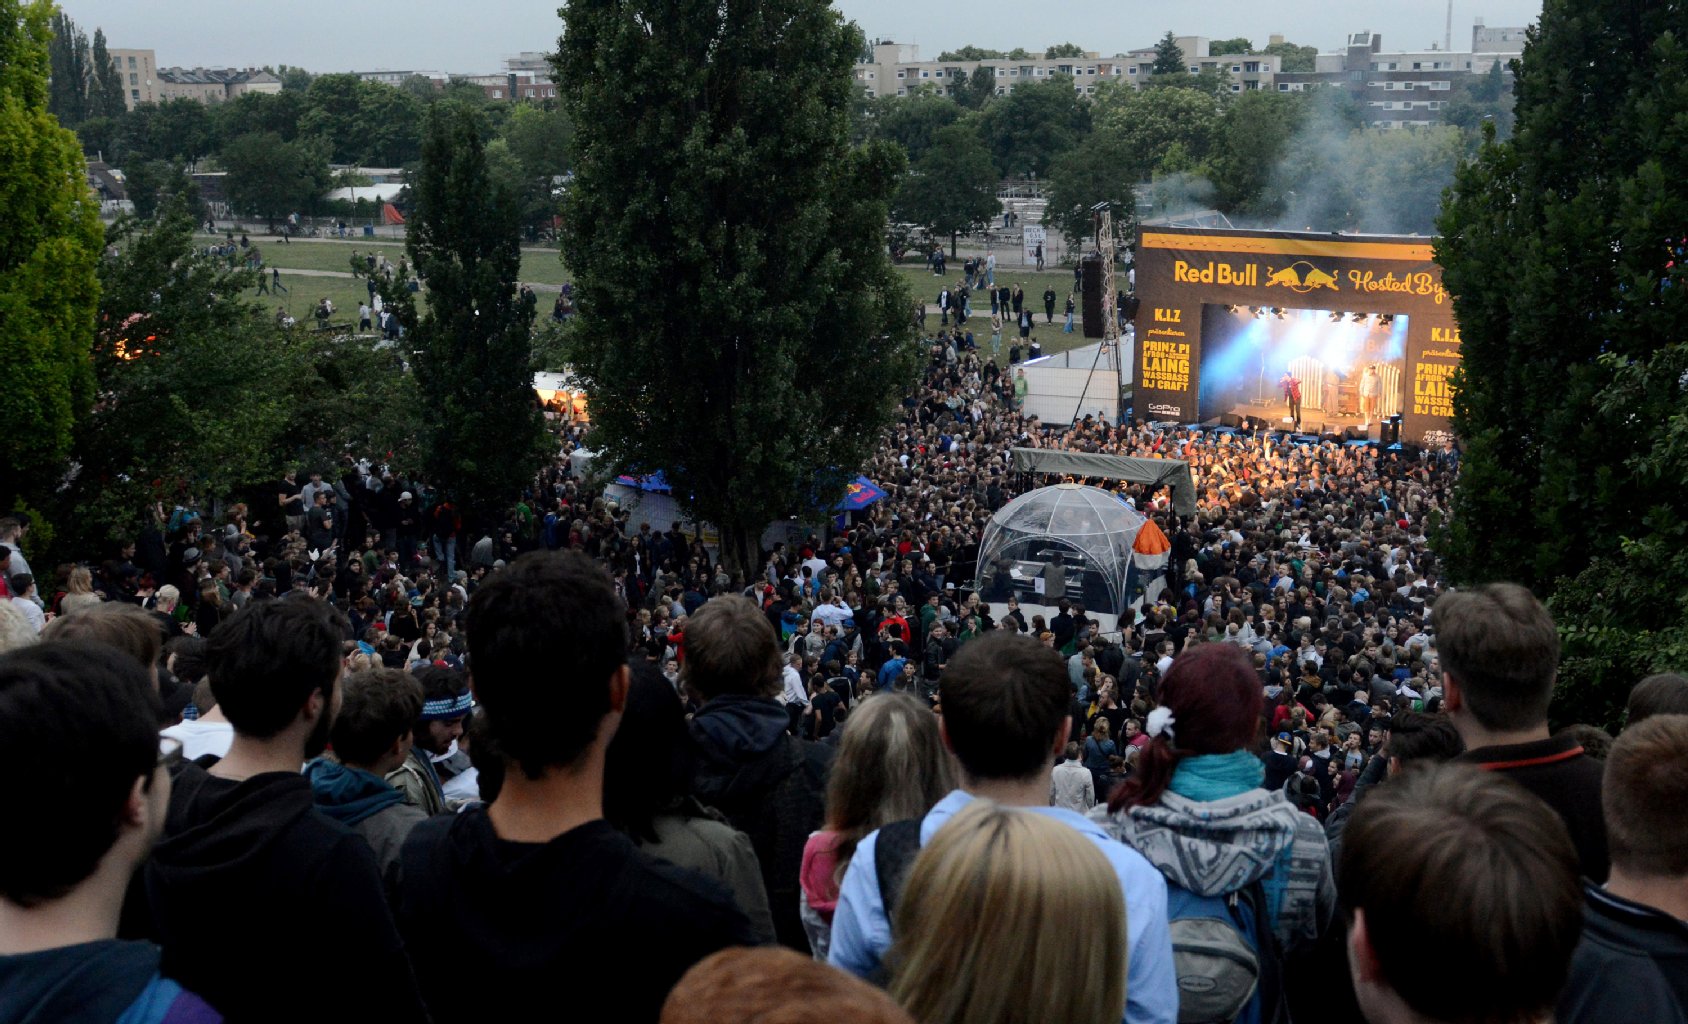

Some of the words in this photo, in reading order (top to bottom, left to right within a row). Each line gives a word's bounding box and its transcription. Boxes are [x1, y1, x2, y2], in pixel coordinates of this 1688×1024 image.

[1174, 260, 1214, 284] Red
[1217, 263, 1257, 286] Bull
[1348, 269, 1415, 294] Hosted
[1413, 272, 1446, 304] By
[1154, 308, 1181, 322] K.I.Z
[1143, 341, 1176, 353] PRINZ
[1179, 343, 1190, 354] PI
[1143, 357, 1189, 374] LAING
[1416, 362, 1455, 378] PRINZ
[1143, 371, 1189, 383] WASSBASS
[1142, 379, 1155, 388] DJ
[1157, 380, 1189, 391] CRAFT
[1148, 403, 1180, 412] GoPro
[1415, 396, 1453, 407] WASSB
[1414, 404, 1429, 414] DJ
[1431, 406, 1455, 417] CRA
